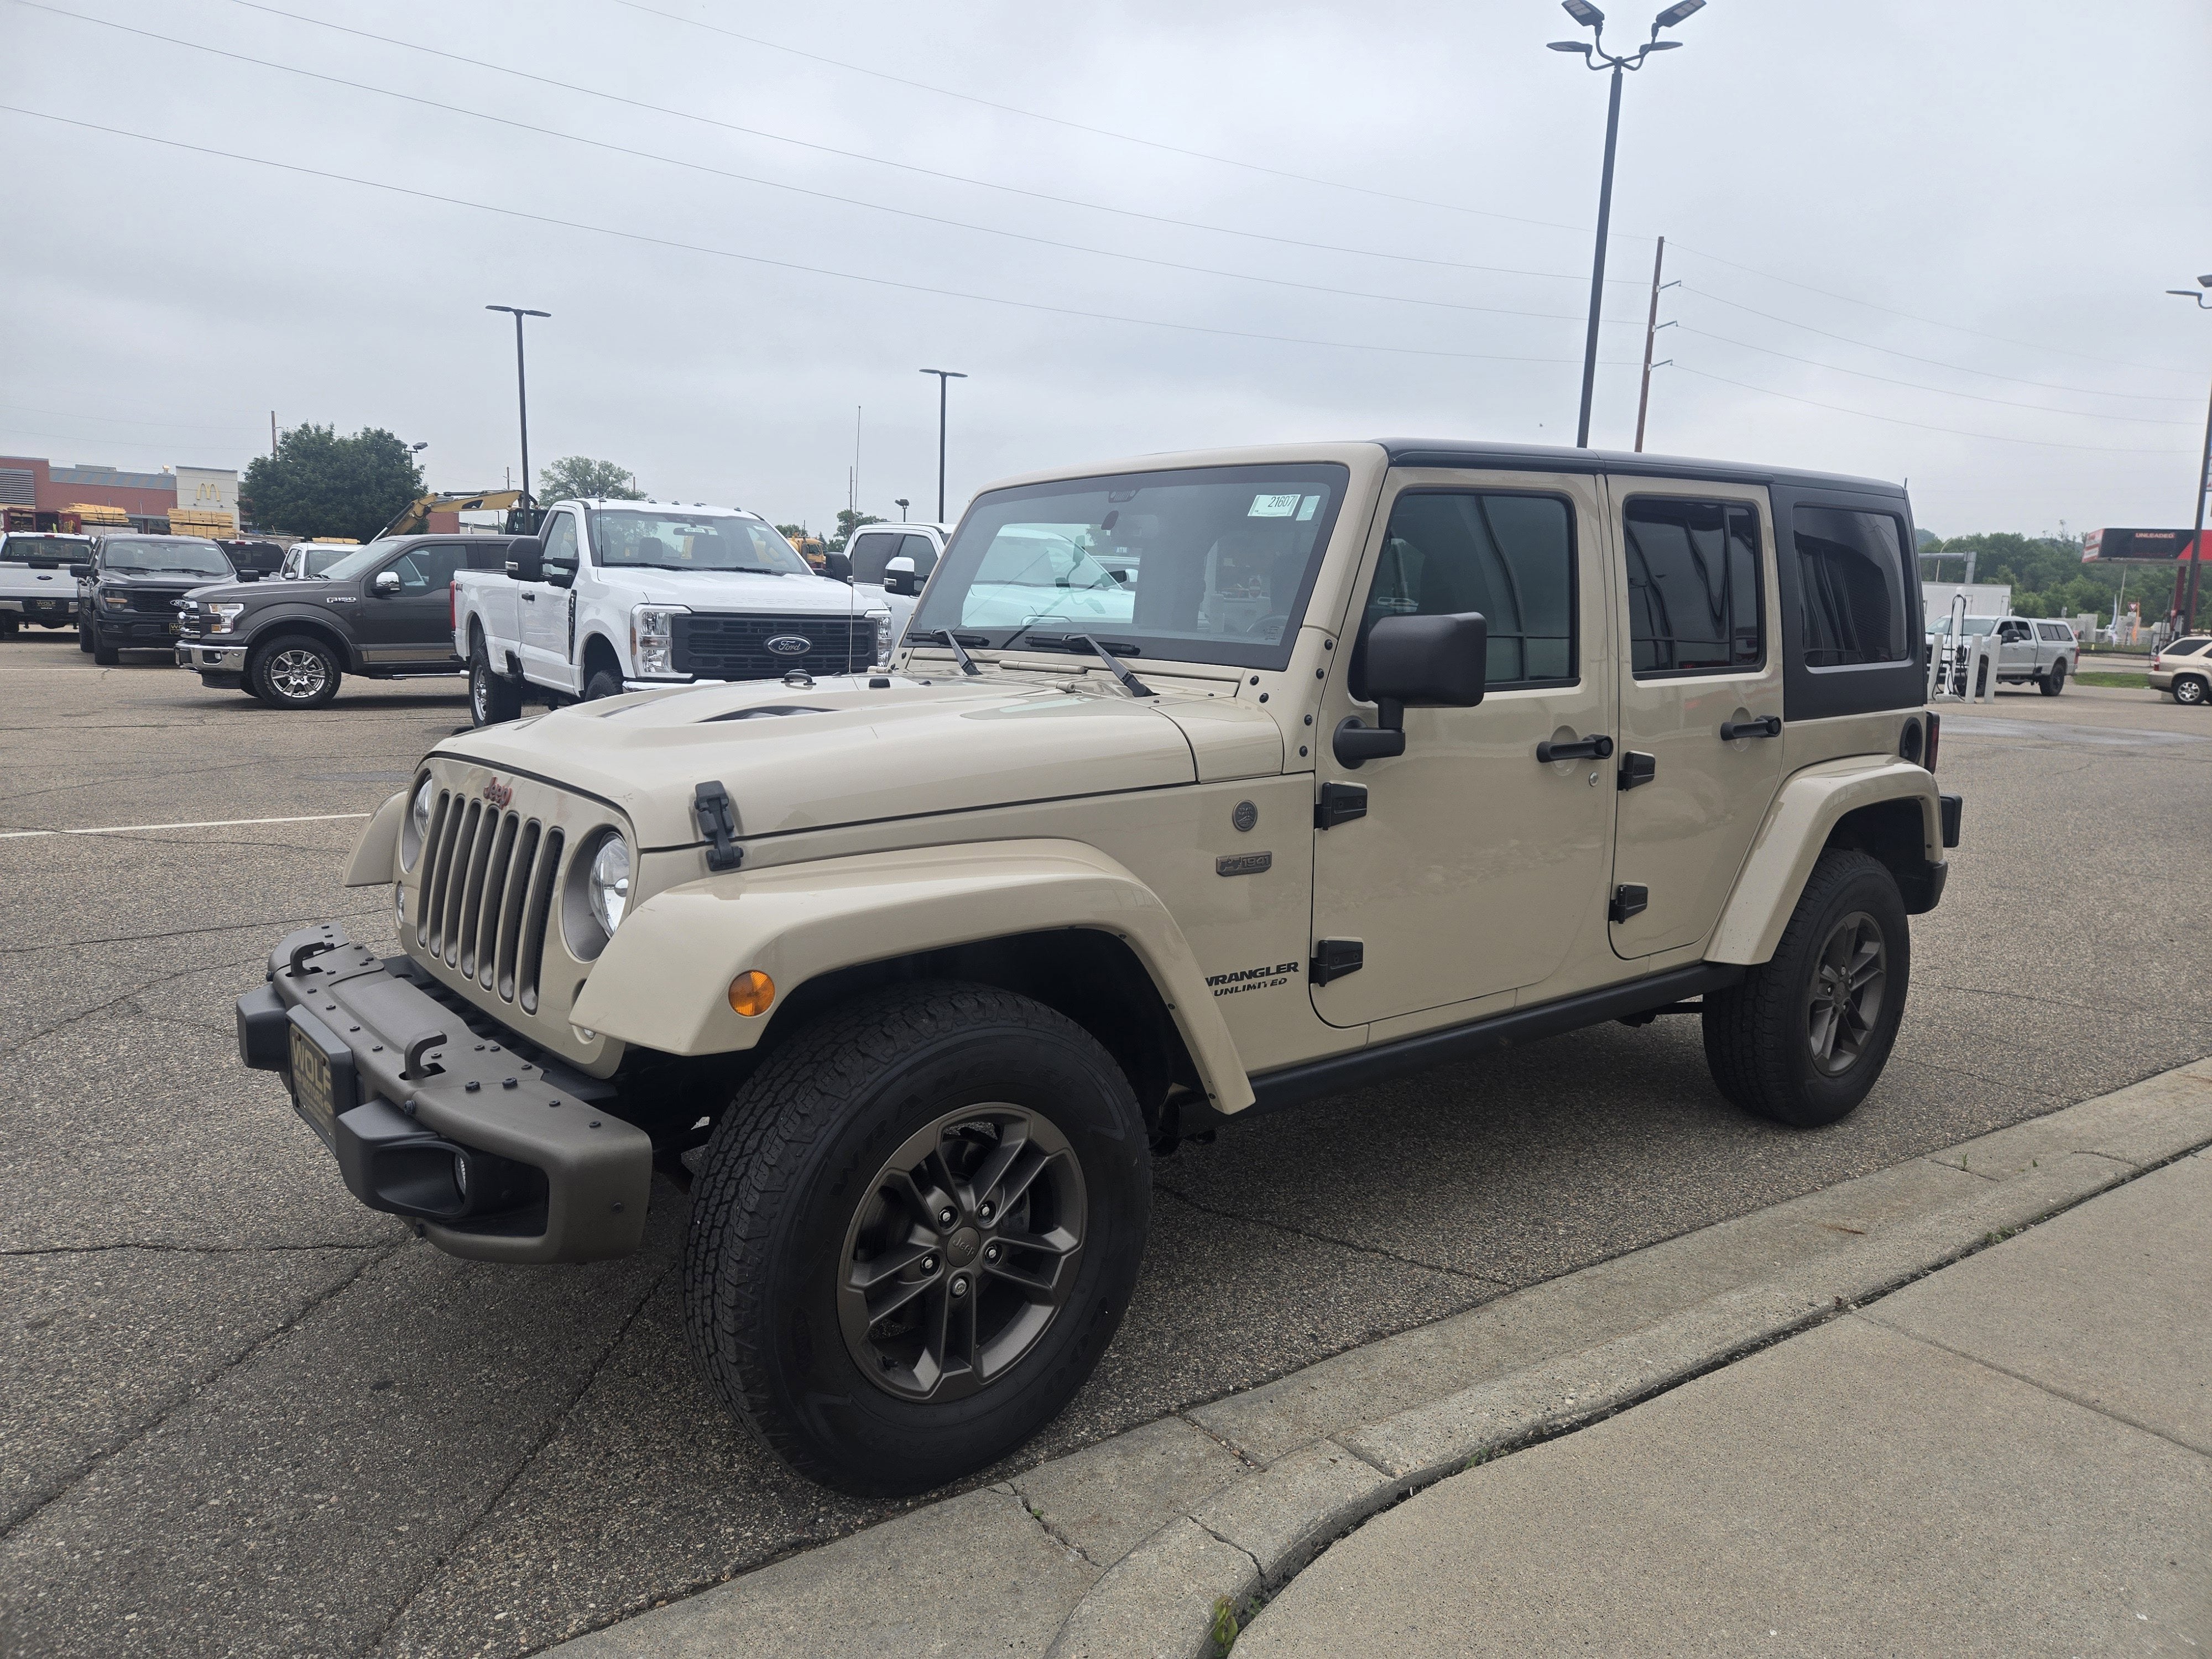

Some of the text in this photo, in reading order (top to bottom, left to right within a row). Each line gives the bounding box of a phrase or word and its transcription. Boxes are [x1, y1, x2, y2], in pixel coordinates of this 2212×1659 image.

[1267, 495, 1295, 508] 21607
[716, 597, 791, 606] SUPER
[778, 640, 801, 651] Ford
[483, 776, 513, 811] Jeep
[1242, 856, 1270, 868] 1941
[1214, 978, 1287, 997] UNLIMITED
[291, 1035, 332, 1095] WOLF
[953, 1237, 975, 1256] Jeep
